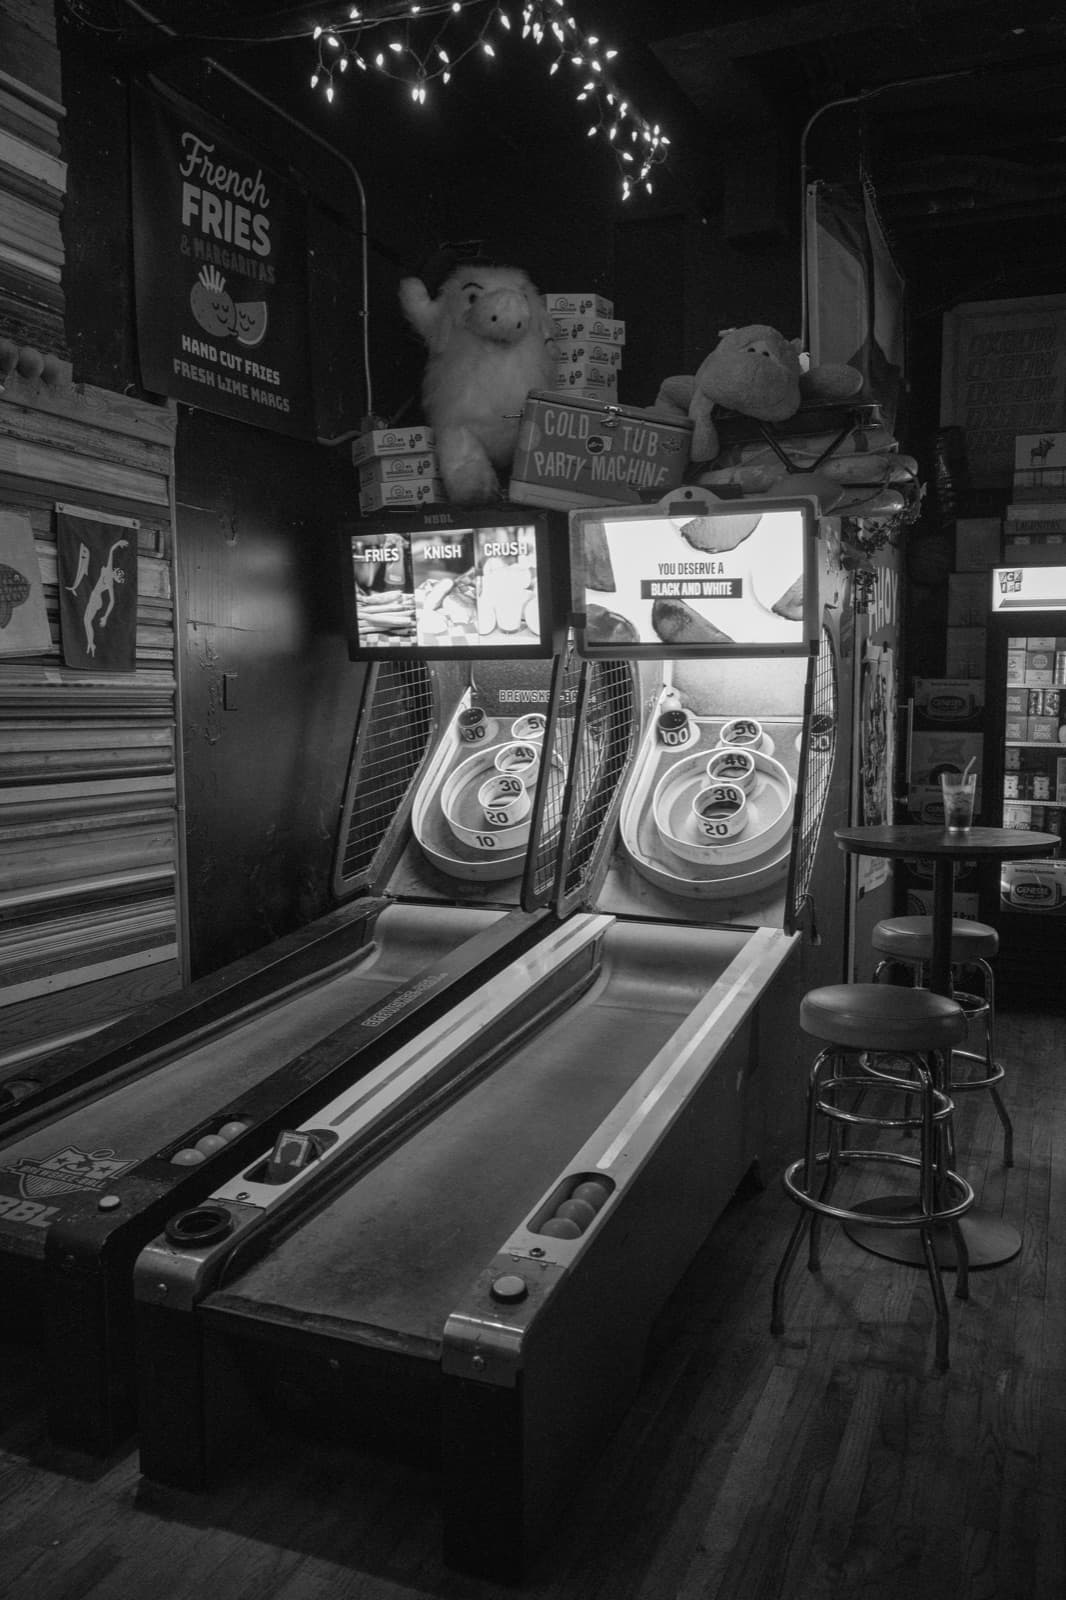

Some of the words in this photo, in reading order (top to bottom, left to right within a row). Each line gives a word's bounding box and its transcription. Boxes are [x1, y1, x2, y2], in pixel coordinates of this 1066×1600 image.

[179, 132, 270, 208] French
[182, 181, 271, 256] FRIES
[180, 234, 191, 257] &
[192, 237, 276, 284] MARGARITAS
[182, 334, 217, 362] HAND
[219, 350, 243, 372] CUT
[244, 359, 281, 386] FRIES
[173, 358, 216, 388] FRESH
[217, 374, 250, 400] LIME
[250, 386, 290, 413] MARGS
[544, 409, 590, 439] COLD
[622, 426, 659, 457] TUB
[533, 450, 587, 481] PARTY
[365, 548, 399, 562] FRIES
[424, 545, 462, 559] KNISH
[484, 542, 528, 556] CRUSH
[658, 562, 676, 575] YOU
[678, 561, 716, 575] DESERVE
[718, 561, 724, 575] A
[651, 582, 681, 597] BLACK
[682, 582, 701, 596] AND
[702, 581, 733, 596] WHITE
[733, 721, 757, 736] 50
[660, 727, 689, 746] 100
[515, 747, 535, 759] 40
[724, 753, 747, 767] 40
[499, 779, 521, 792] 30
[713, 788, 738, 801] 30
[487, 811, 509, 824] 20
[703, 823, 728, 836] 20
[476, 835, 495, 848] 10
